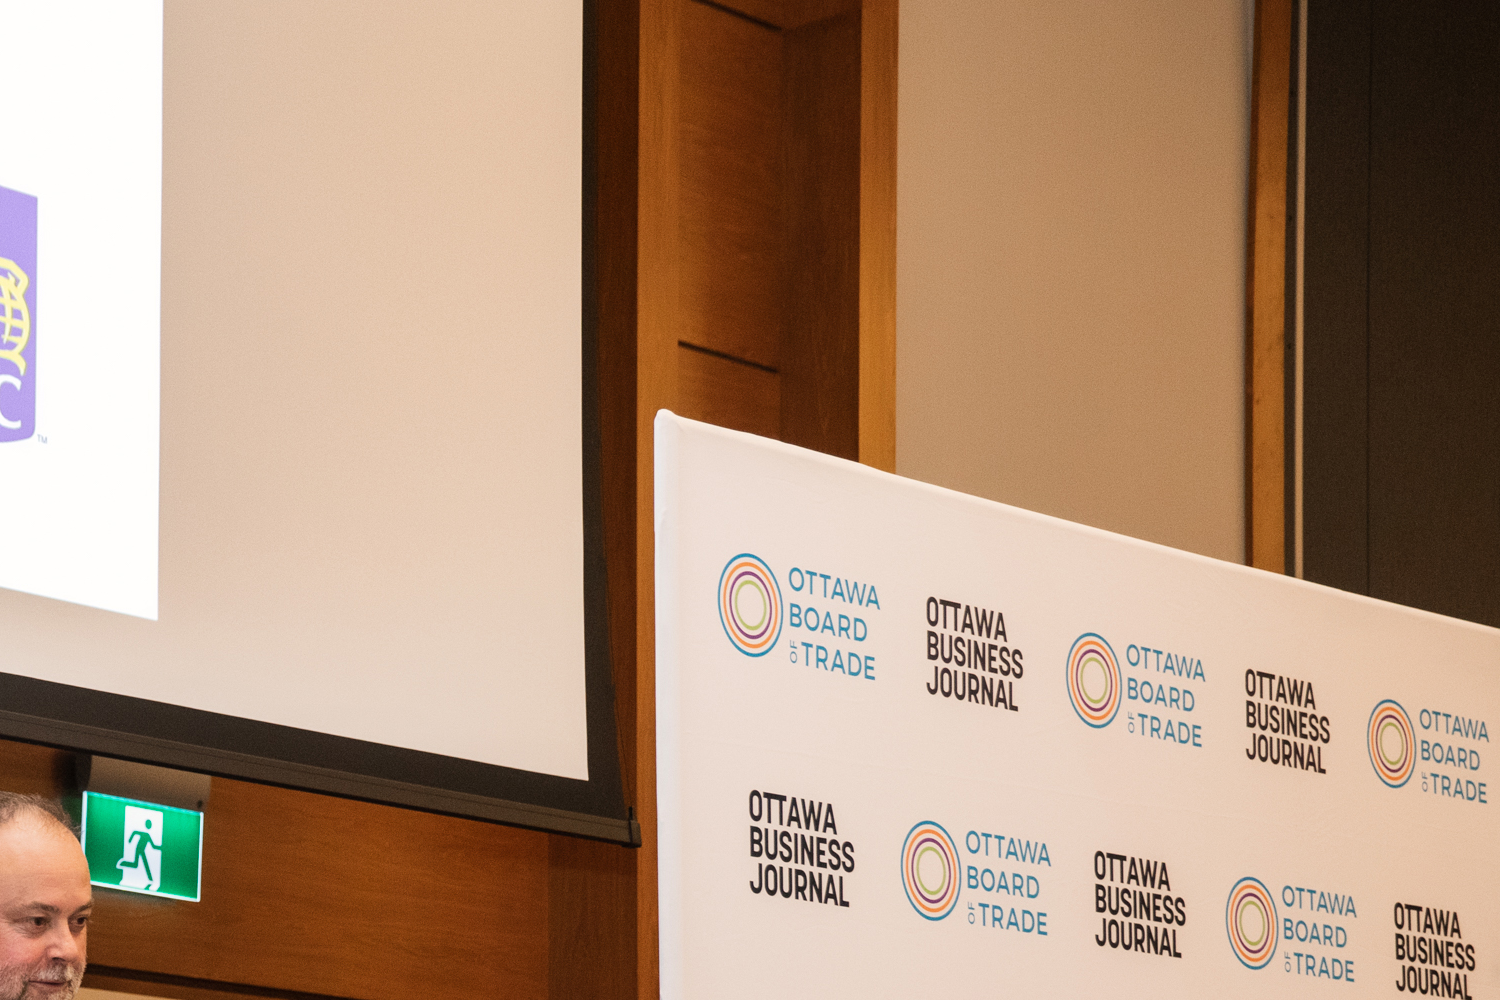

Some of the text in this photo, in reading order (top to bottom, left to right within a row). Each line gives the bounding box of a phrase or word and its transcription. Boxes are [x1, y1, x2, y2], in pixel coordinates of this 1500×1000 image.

[789, 567, 880, 609] OTTAWA
[790, 603, 867, 642] BOARD
[927, 597, 1007, 642] OTTAWA
[801, 642, 875, 680] TRADE
[927, 631, 1023, 679] BUSINESS
[1127, 644, 1205, 681] OTTAWA
[927, 666, 1018, 711] JOURNAL
[1128, 677, 1194, 712] BOARD
[1245, 669, 1316, 710] OTTAWA
[1138, 713, 1202, 747] TRADE
[1246, 700, 1330, 744] BUSINESS
[1420, 709, 1489, 742] OTTAWA
[1246, 733, 1326, 774] JOURNAL
[1421, 740, 1480, 771] BOARD
[1430, 773, 1487, 804] TRADE
[749, 790, 837, 835] OTTAWA
[750, 826, 855, 873] BUSINESS
[966, 831, 1051, 866] OTTAWA
[750, 863, 849, 907] JOURNAL
[967, 866, 1039, 899] BOARD
[1094, 851, 1170, 891] OTTAWA
[978, 903, 1047, 935] TRADE
[1095, 884, 1186, 926] BUSINESS
[1282, 885, 1356, 917] OTTAWA
[1394, 902, 1461, 938] OTTAWA
[1095, 918, 1182, 958] JOURNAL
[1284, 918, 1347, 948] BOARD
[1395, 933, 1475, 971] BUSINESS
[1294, 952, 1354, 982] TRADE
[1396, 965, 1472, 1000] JOURNAL
